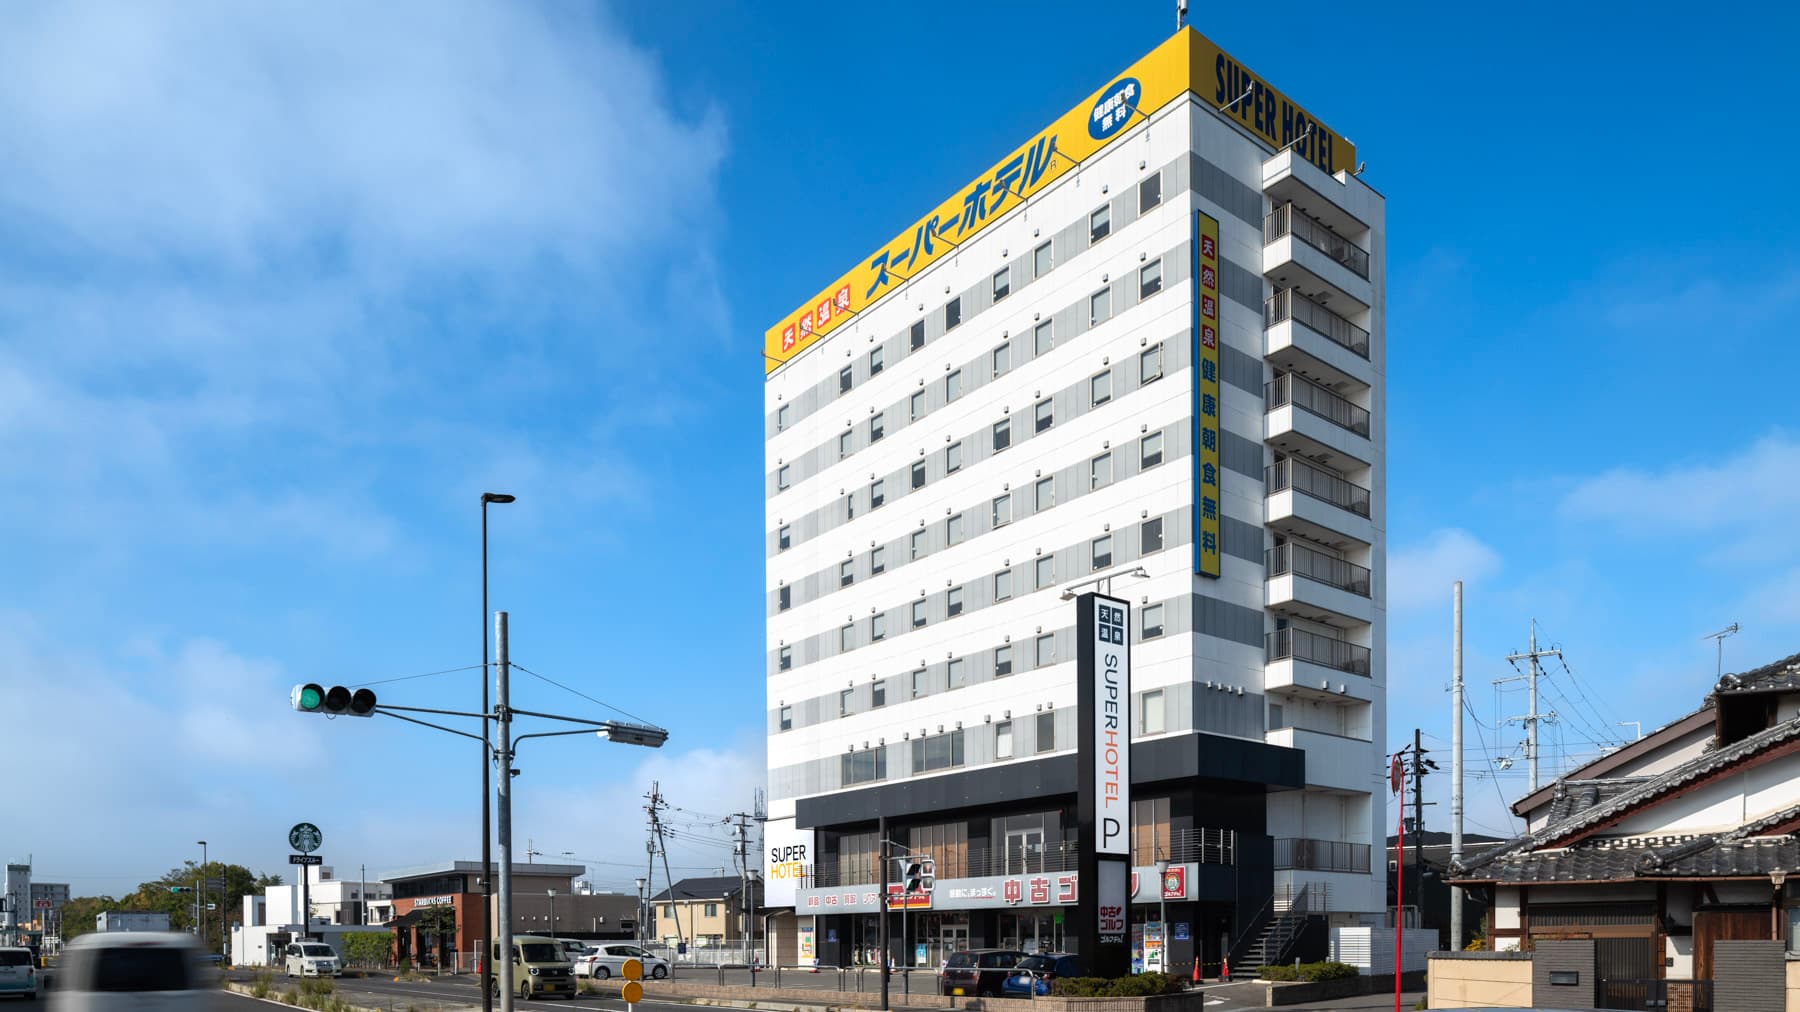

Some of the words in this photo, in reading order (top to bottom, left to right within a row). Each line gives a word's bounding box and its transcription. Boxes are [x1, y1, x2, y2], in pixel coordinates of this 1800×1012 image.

[1216, 53, 1276, 141] SUPER
[1282, 100, 1335, 176] HOTEL
[866, 134, 1057, 300] スーパーホテル
[783, 287, 849, 351] 天然温泉
[1103, 817, 1121, 849] P
[771, 844, 806, 863] SUPER
[771, 862, 805, 879] HOTEL
[1101, 905, 1116, 918] 中古
[1100, 919, 1124, 931] ゴルフ
